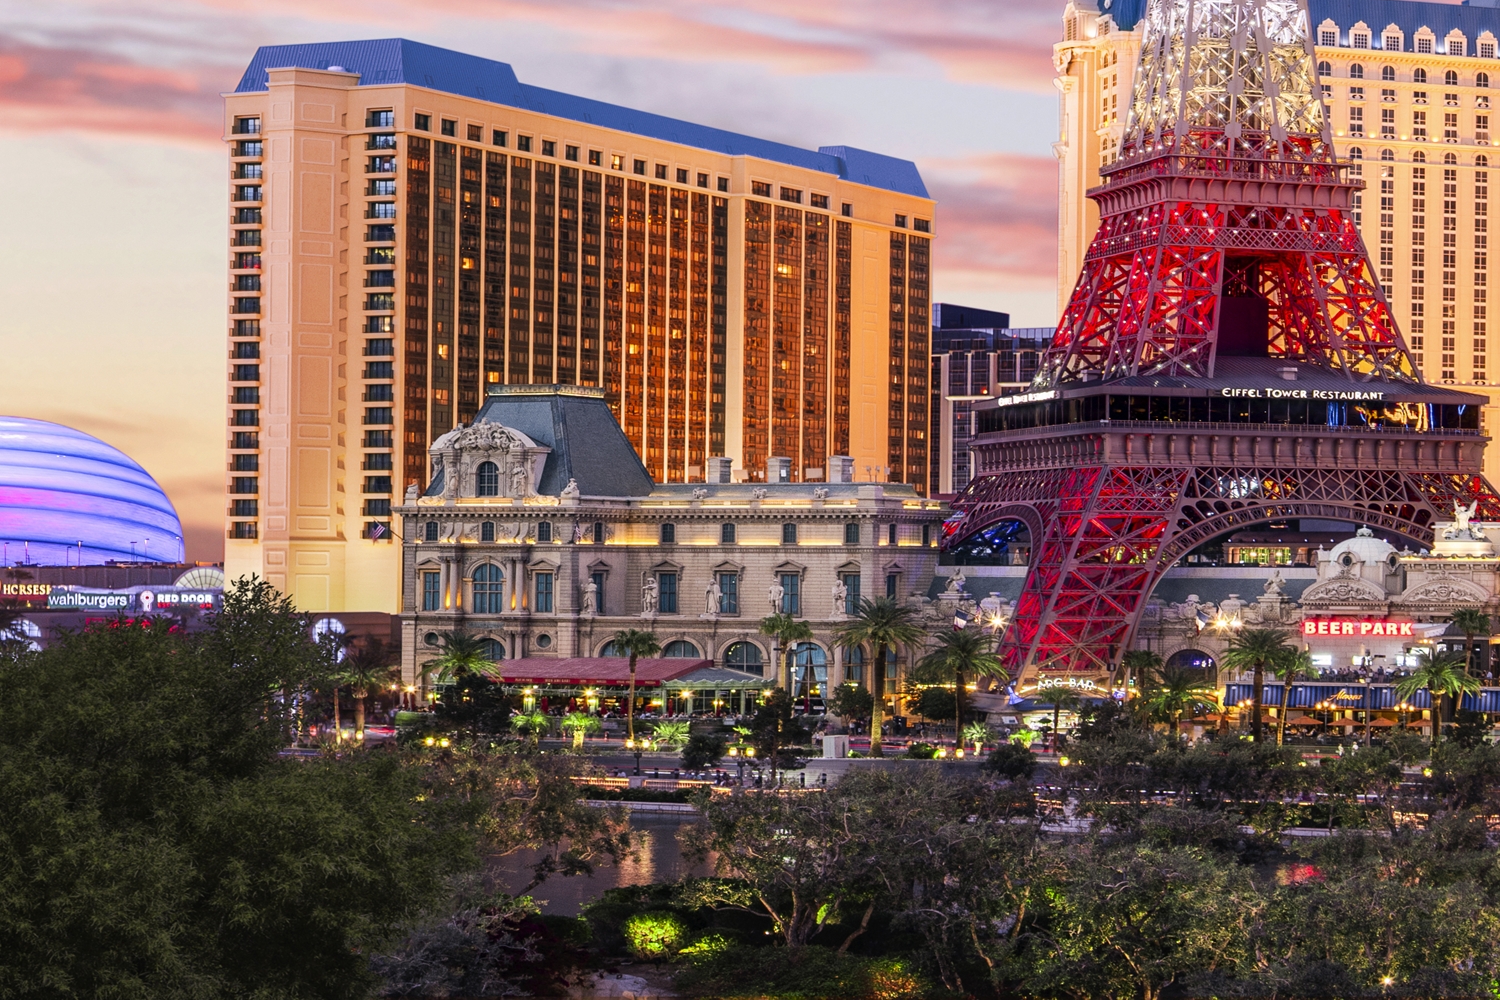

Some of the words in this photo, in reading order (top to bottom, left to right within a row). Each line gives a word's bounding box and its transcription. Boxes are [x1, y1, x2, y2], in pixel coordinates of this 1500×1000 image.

[1222, 387, 1263, 398] EIFFEL
[1265, 388, 1308, 399] TOWER
[1312, 389, 1384, 400] RESTAURANT
[48, 593, 128, 608] wahlburgers
[157, 594, 179, 603] RED
[181, 594, 212, 603] DOOR
[1304, 621, 1354, 635] BEER
[1360, 622, 1412, 636] PARK
[1068, 678, 1094, 691] BAR
